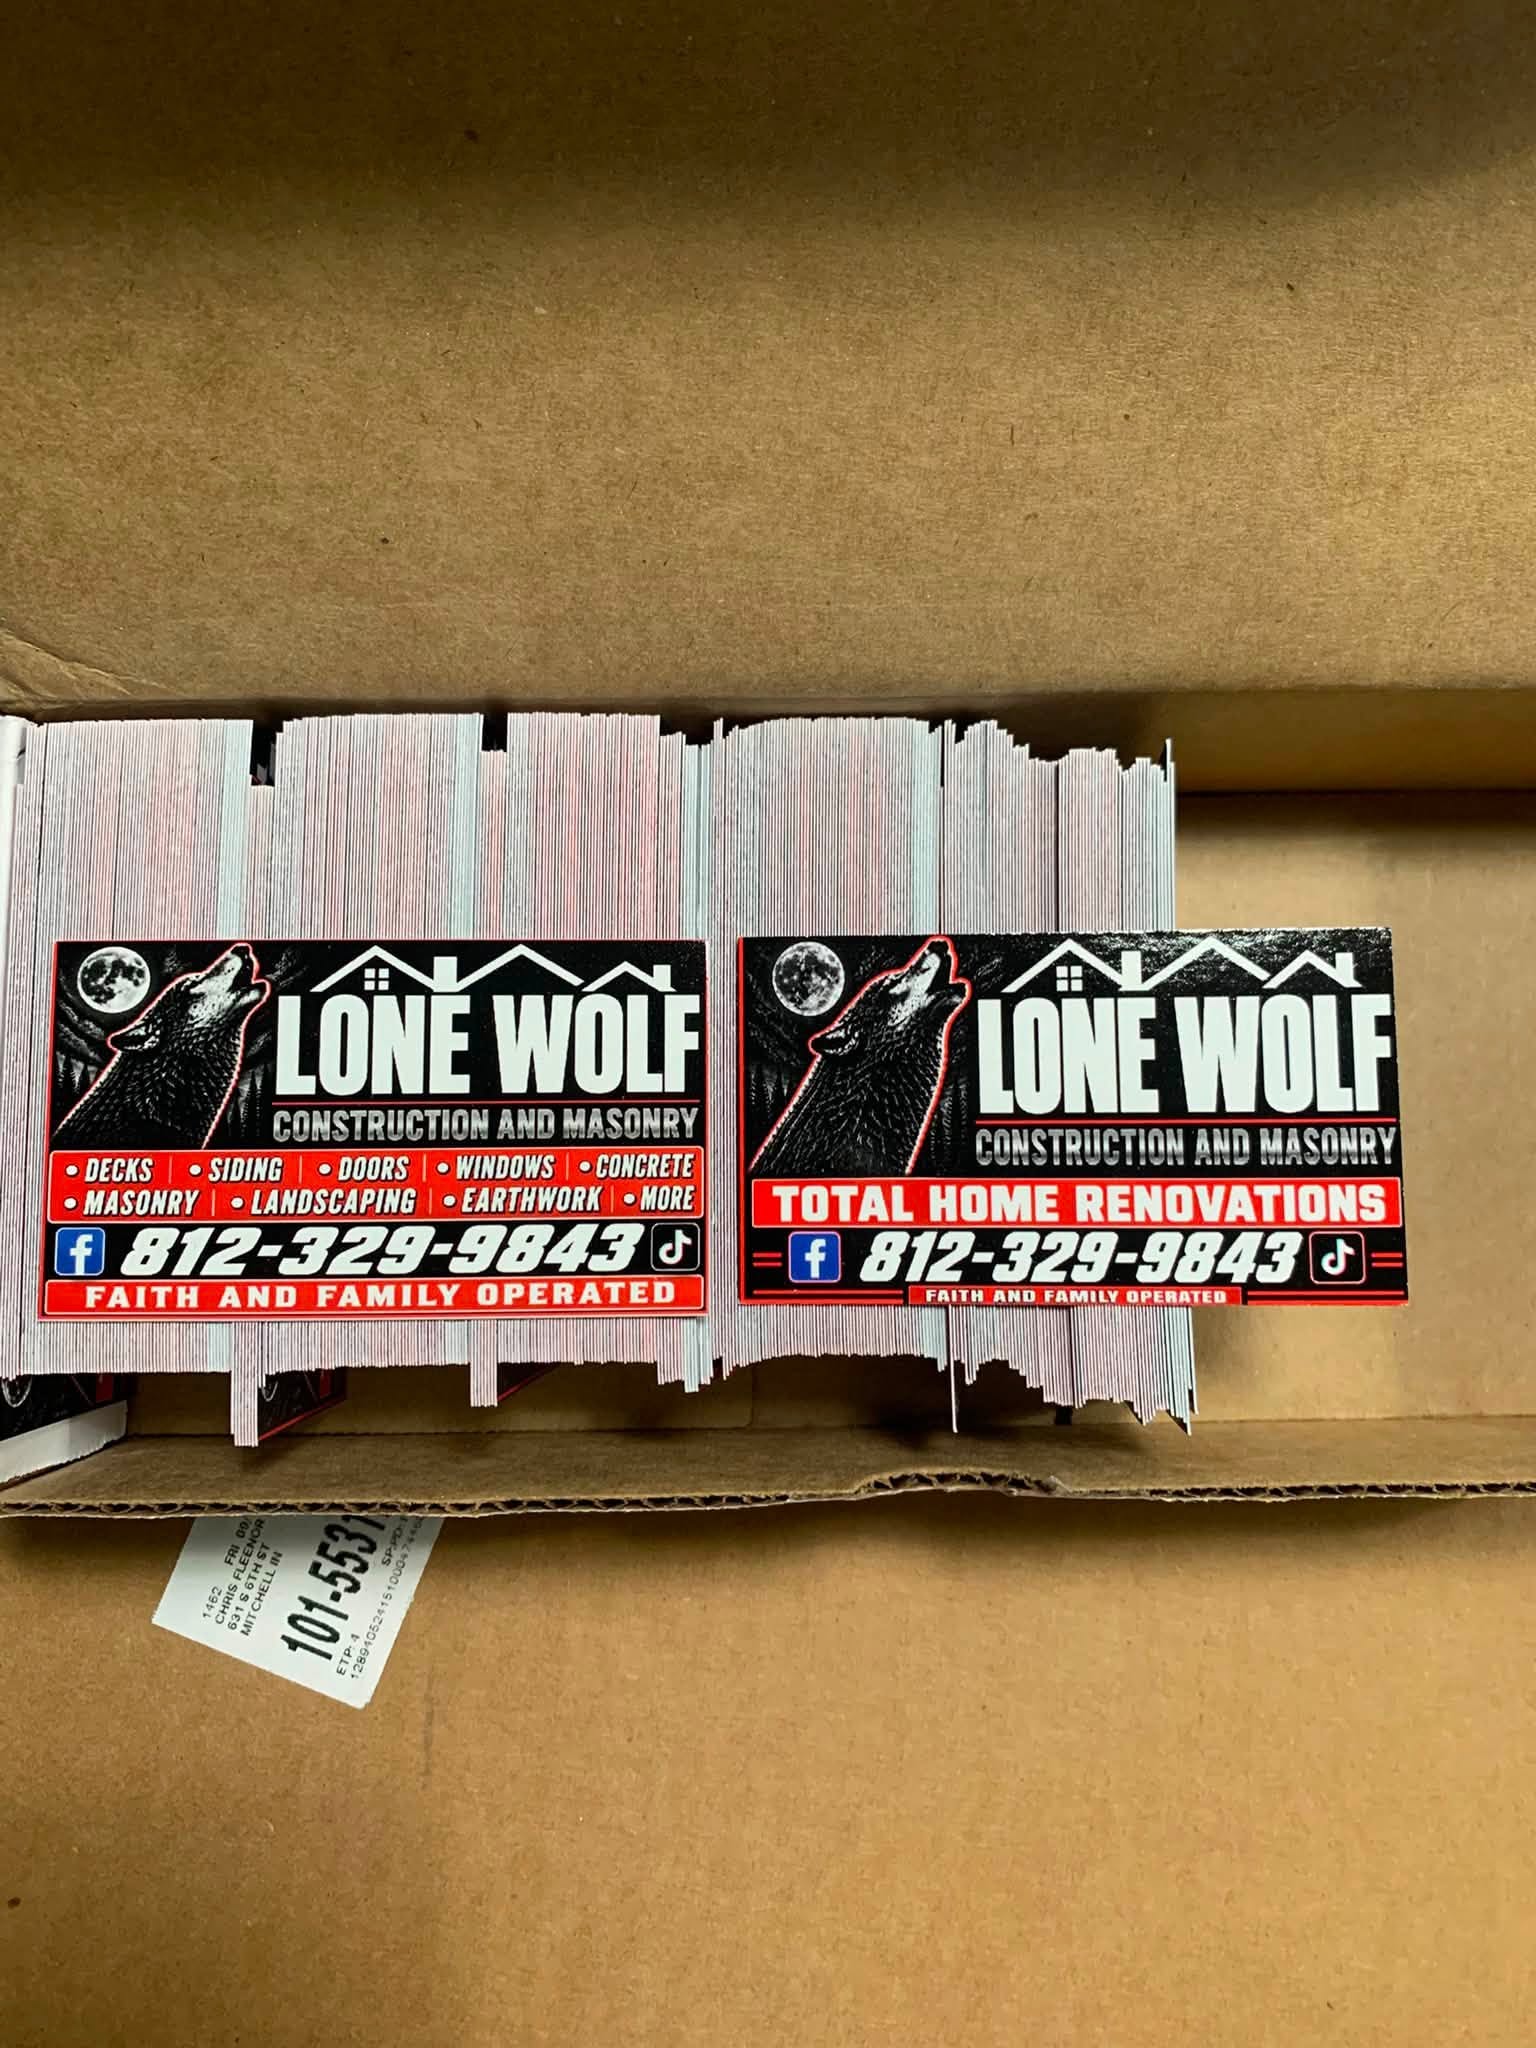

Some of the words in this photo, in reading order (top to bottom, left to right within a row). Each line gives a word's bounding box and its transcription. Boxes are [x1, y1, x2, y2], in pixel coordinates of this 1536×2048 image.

[275, 993, 471, 1096] LONE
[492, 993, 701, 1095] WOLF
[976, 997, 1160, 1114] LONE
[1173, 995, 1392, 1113] WOLF
[273, 1109, 489, 1142] CONSTRUCTION
[497, 1109, 556, 1139] AND
[562, 1107, 699, 1139] MASONRY
[975, 1129, 1184, 1165] CONSTRUCTION
[1194, 1129, 1252, 1165] AND
[1260, 1127, 1397, 1165] MASONRY
[84, 1157, 153, 1183] DECKS
[207, 1156, 283, 1182] SIDING
[337, 1155, 409, 1181] DOORS
[455, 1155, 556, 1180] WINDOWS
[595, 1153, 694, 1179] CONCRETE
[83, 1189, 199, 1216] MASONRY
[250, 1188, 417, 1215] LANDSCAPING
[461, 1187, 602, 1213] EARTHWORK
[640, 1186, 694, 1211] MORE
[772, 1185, 915, 1222] TOTAL
[930, 1185, 1059, 1222] HOME
[1075, 1184, 1386, 1223] RENOVATIONS
[120, 1223, 645, 1276] 812-329-9843
[859, 1231, 1302, 1283] 812-329-9843
[85, 1285, 199, 1308] FAITH
[219, 1285, 296, 1307] AND
[317, 1284, 460, 1307] FAMILY
[477, 1281, 676, 1306] OPERATED
[925, 1290, 985, 1303] FAITH
[992, 1290, 1036, 1303] AND
[1043, 1290, 1118, 1303] FAMILY
[1126, 1290, 1226, 1303] OPERATED
[202, 1586, 222, 1618] 1462
[224, 1544, 241, 1566] FRI
[215, 1583, 238, 1624] CHRIS
[233, 1518, 265, 1581] FLEENOR
[227, 1606, 243, 1631] 631
[239, 1592, 249, 1602] S
[245, 1562, 263, 1590] 6TH
[257, 1541, 271, 1561] ST
[241, 1569, 276, 1636] MITCHELL
[270, 1551, 283, 1566] IN
[280, 1515, 385, 1661] 101-5531
